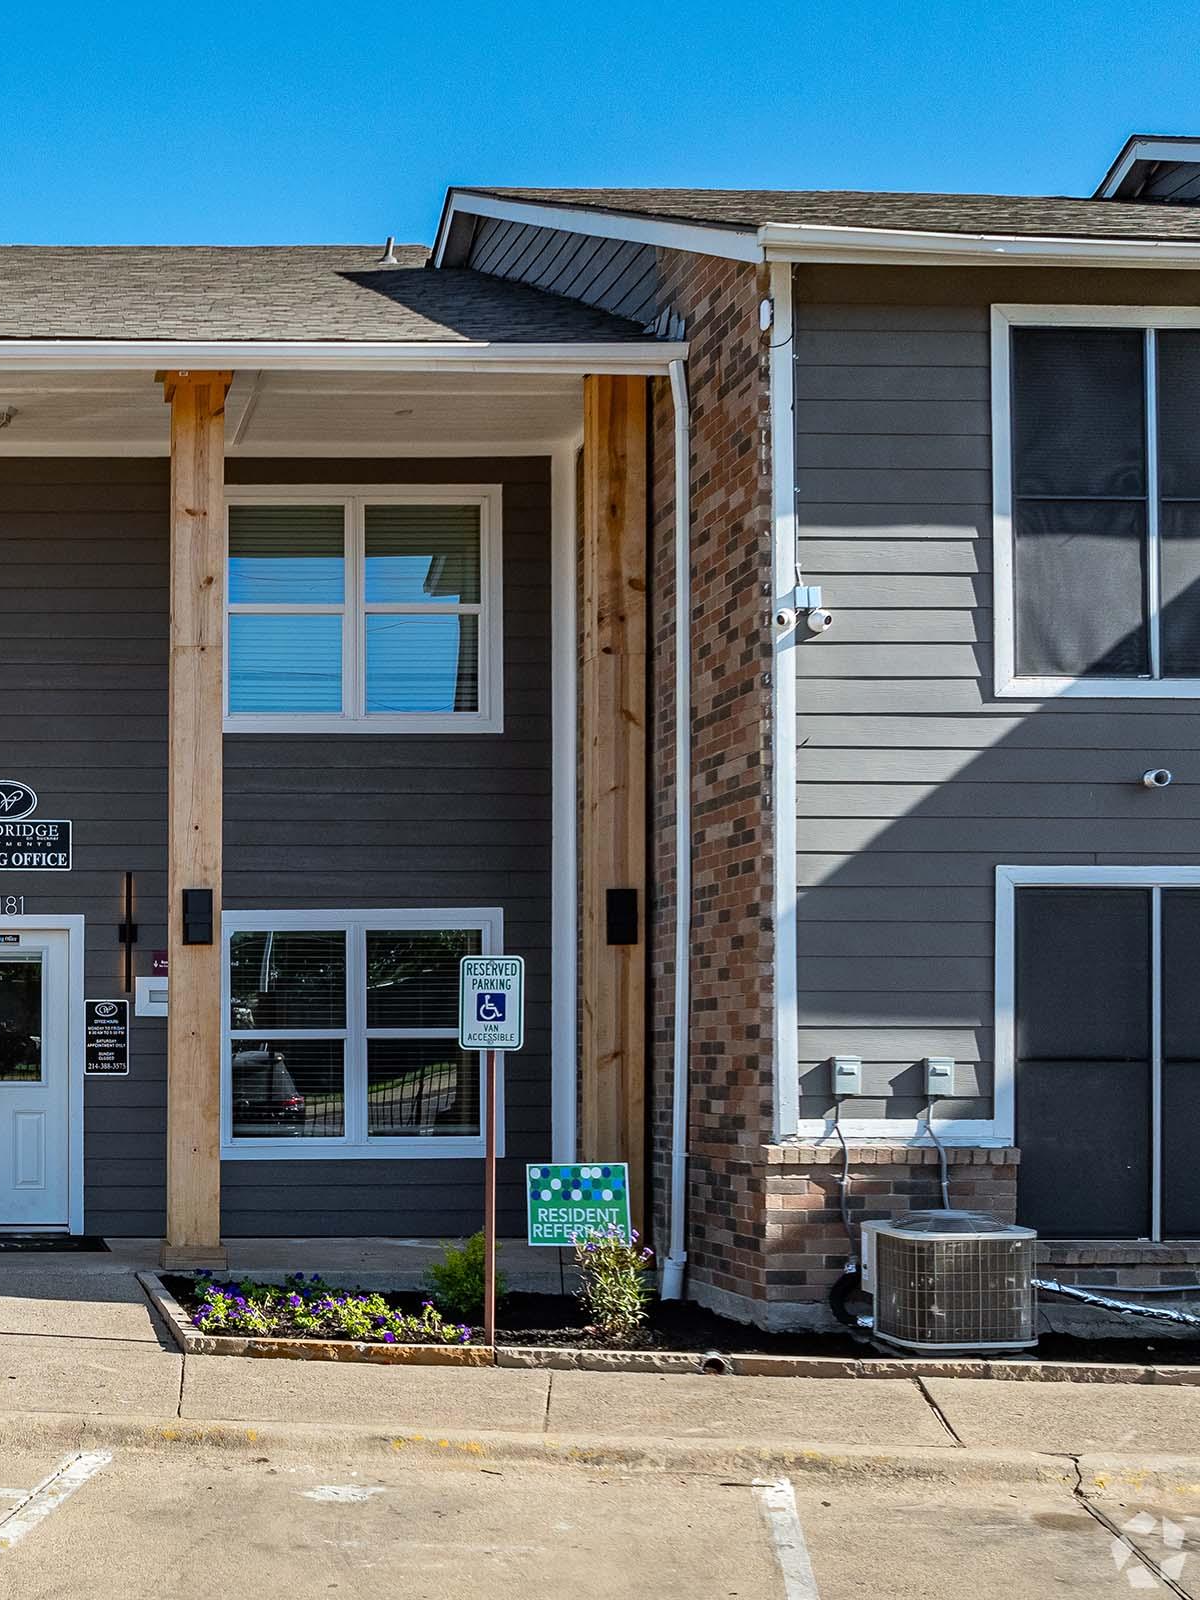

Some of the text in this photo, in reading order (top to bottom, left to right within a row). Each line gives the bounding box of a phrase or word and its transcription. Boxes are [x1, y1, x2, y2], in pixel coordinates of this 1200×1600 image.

[11, 852, 68, 866] OFFICE
[466, 962, 518, 976] RESERVED
[471, 978, 512, 991] PARKING
[484, 1024, 499, 1032] VAN
[467, 1033, 515, 1041] ACCESSIBLE
[538, 1207, 620, 1223] RESIDENT
[532, 1223, 626, 1239] REFERRAS
